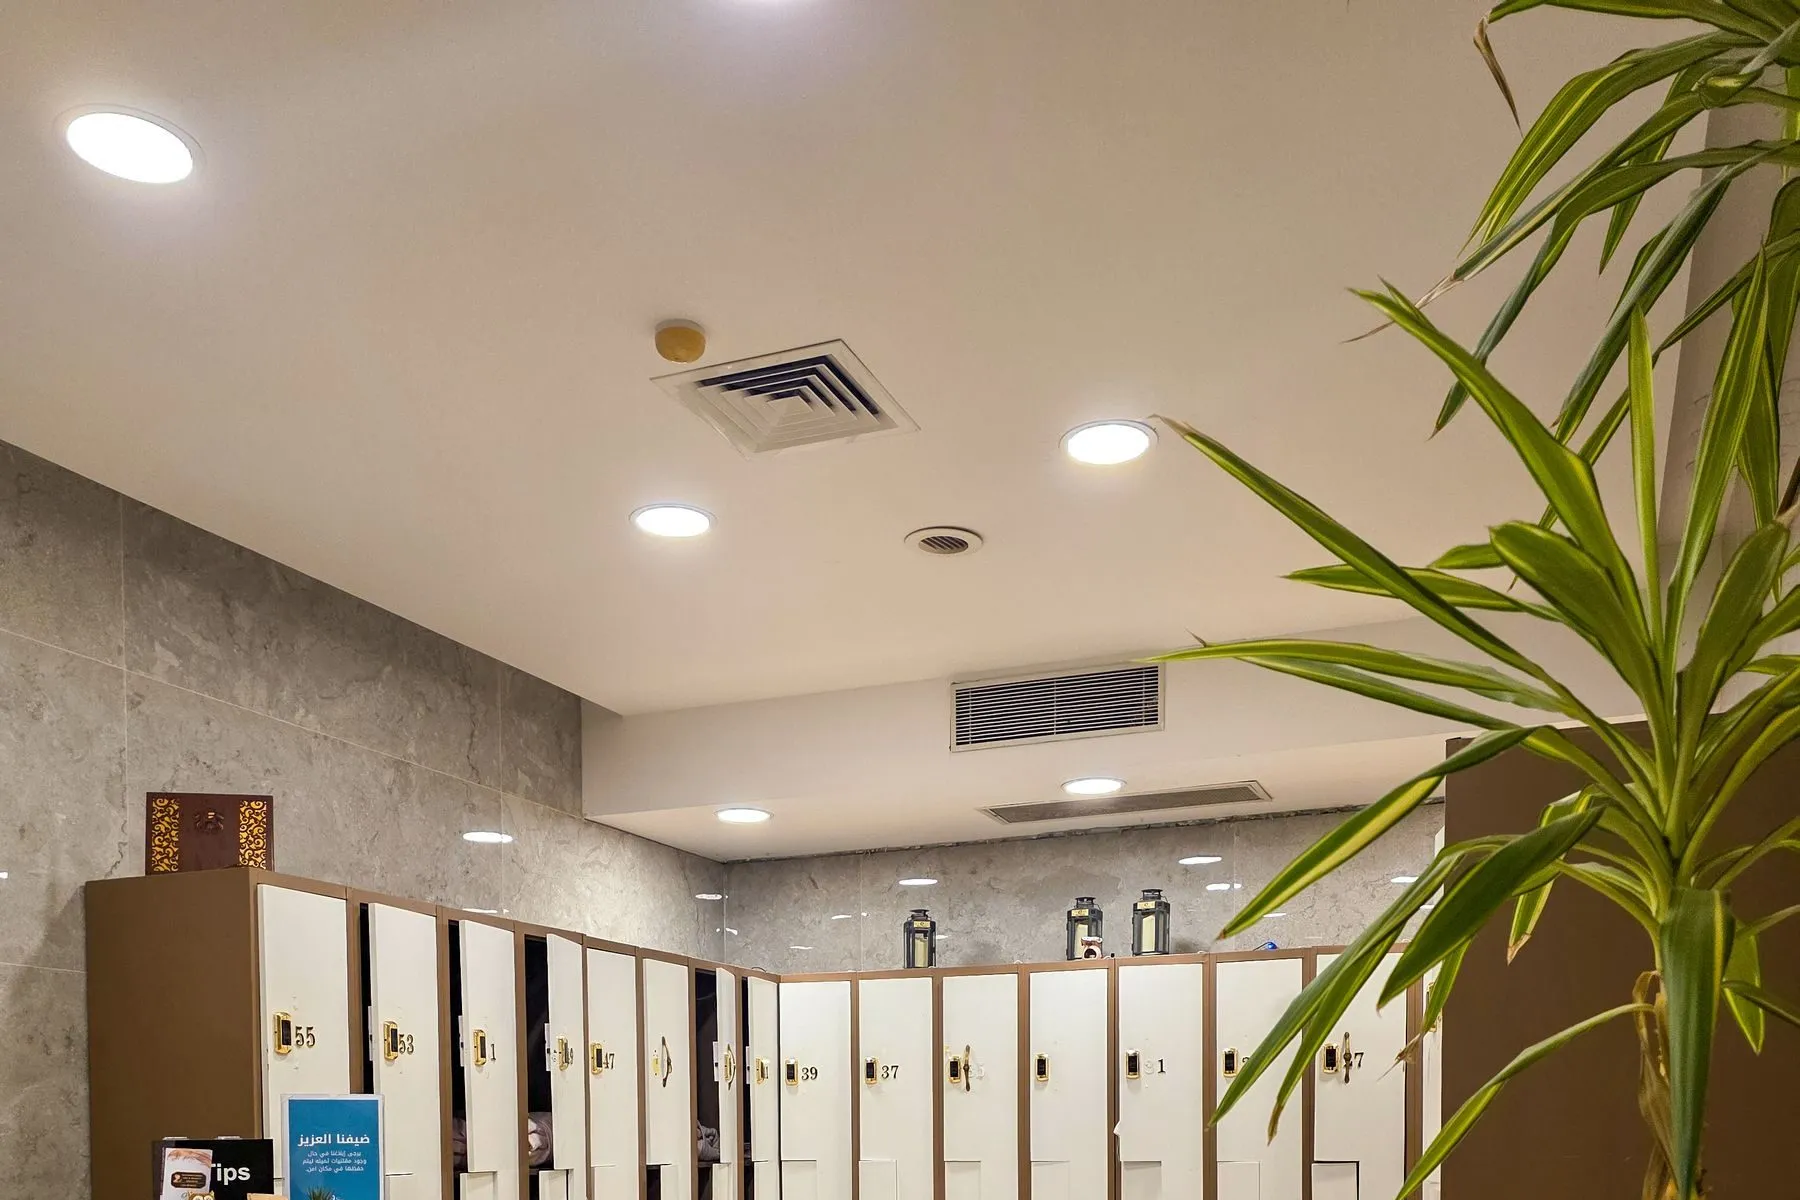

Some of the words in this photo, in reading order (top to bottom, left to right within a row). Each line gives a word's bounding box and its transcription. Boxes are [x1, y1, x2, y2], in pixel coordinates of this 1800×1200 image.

[294, 1026, 316, 1047] 55
[398, 1034, 415, 1054] 53
[602, 1053, 615, 1070] 47
[801, 1066, 818, 1081] 39
[880, 1065, 899, 1079] 37
[297, 1133, 332, 1147] العزيز
[336, 1133, 370, 1147] ضيفنا
